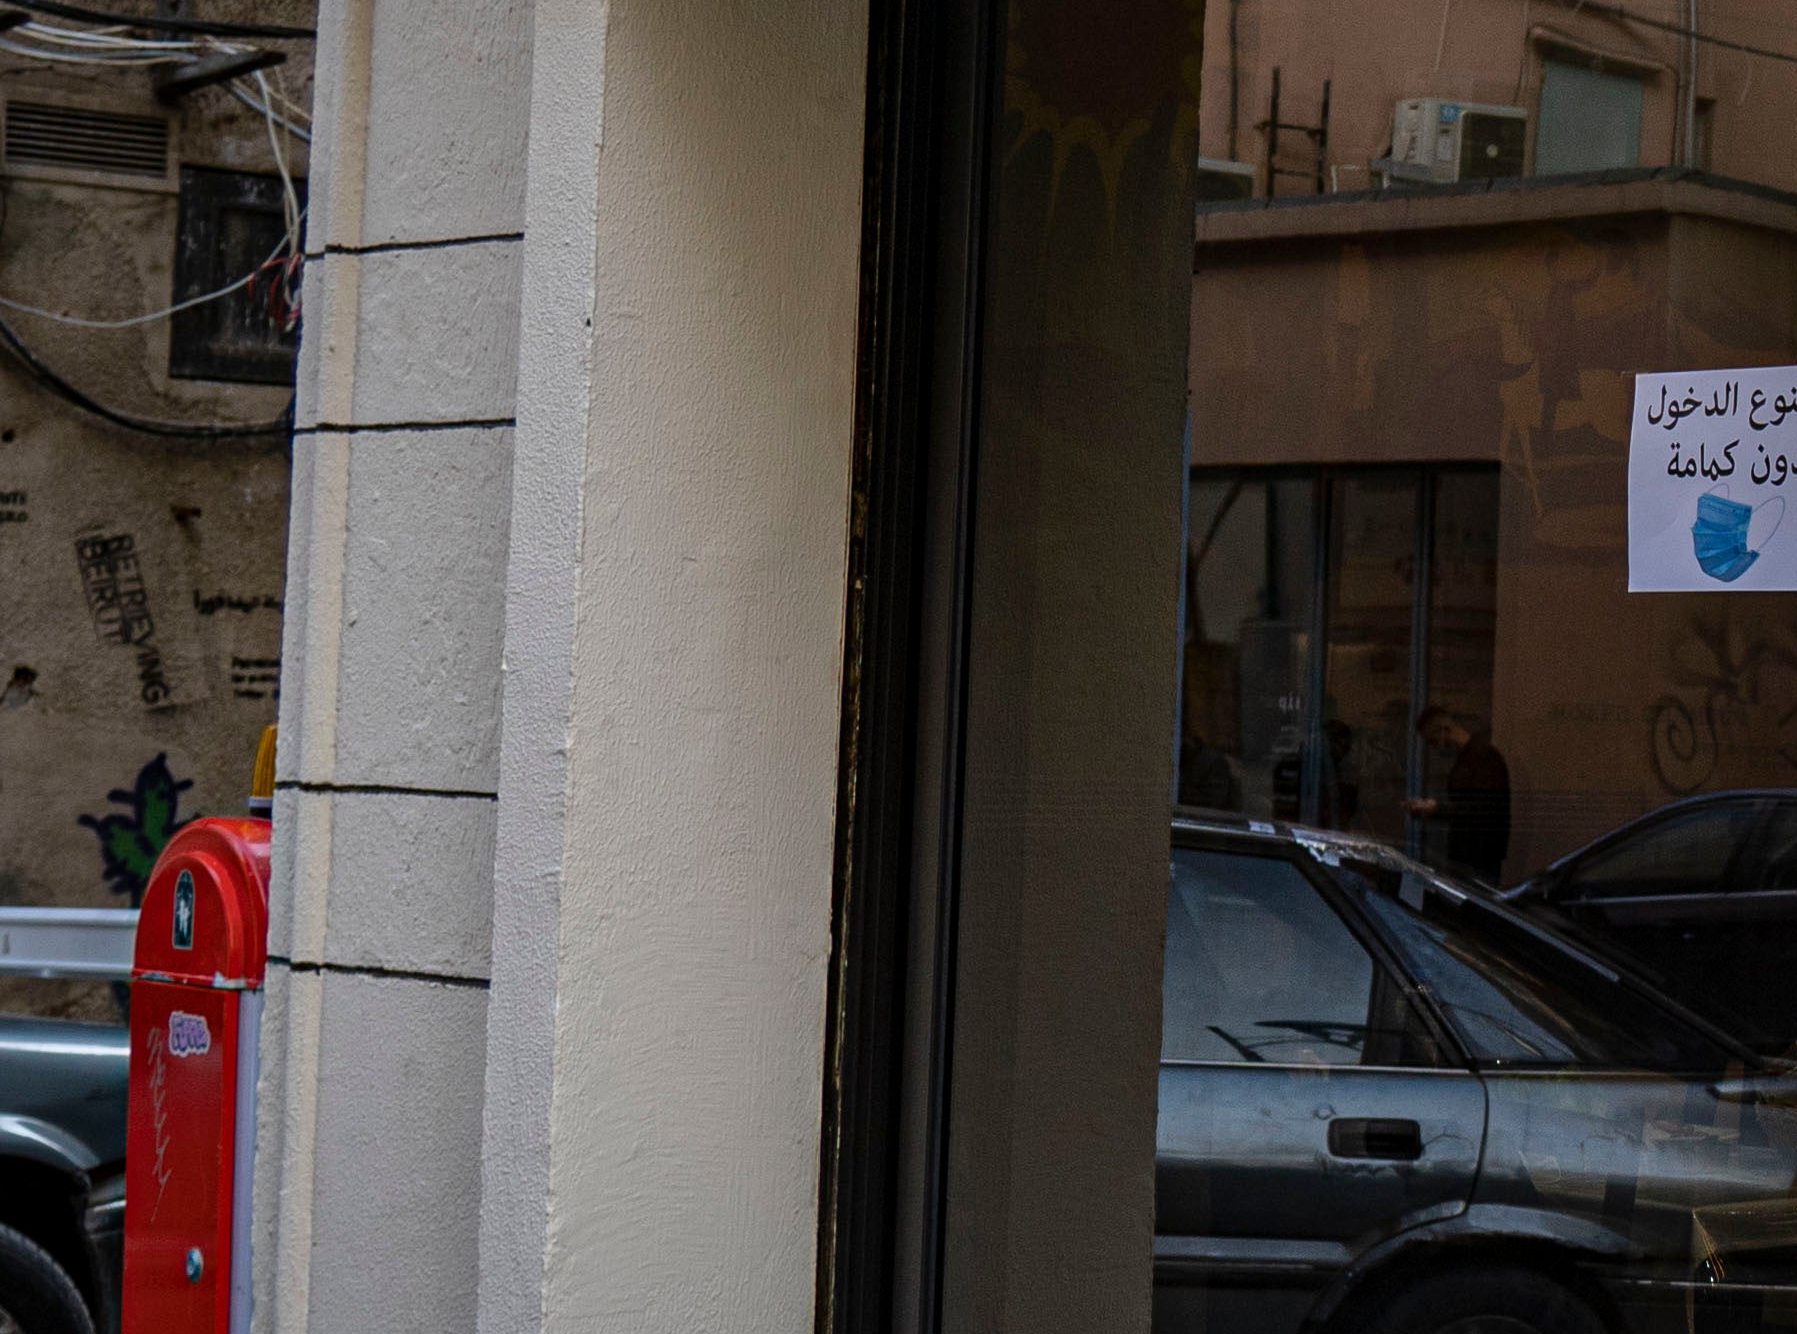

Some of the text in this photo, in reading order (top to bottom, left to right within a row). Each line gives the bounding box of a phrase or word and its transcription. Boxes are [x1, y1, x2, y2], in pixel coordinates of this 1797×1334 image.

[1647, 380, 1739, 431] الدخول
[1666, 438, 1741, 482] كمامة
[107, 534, 171, 704] RETRIEVING
